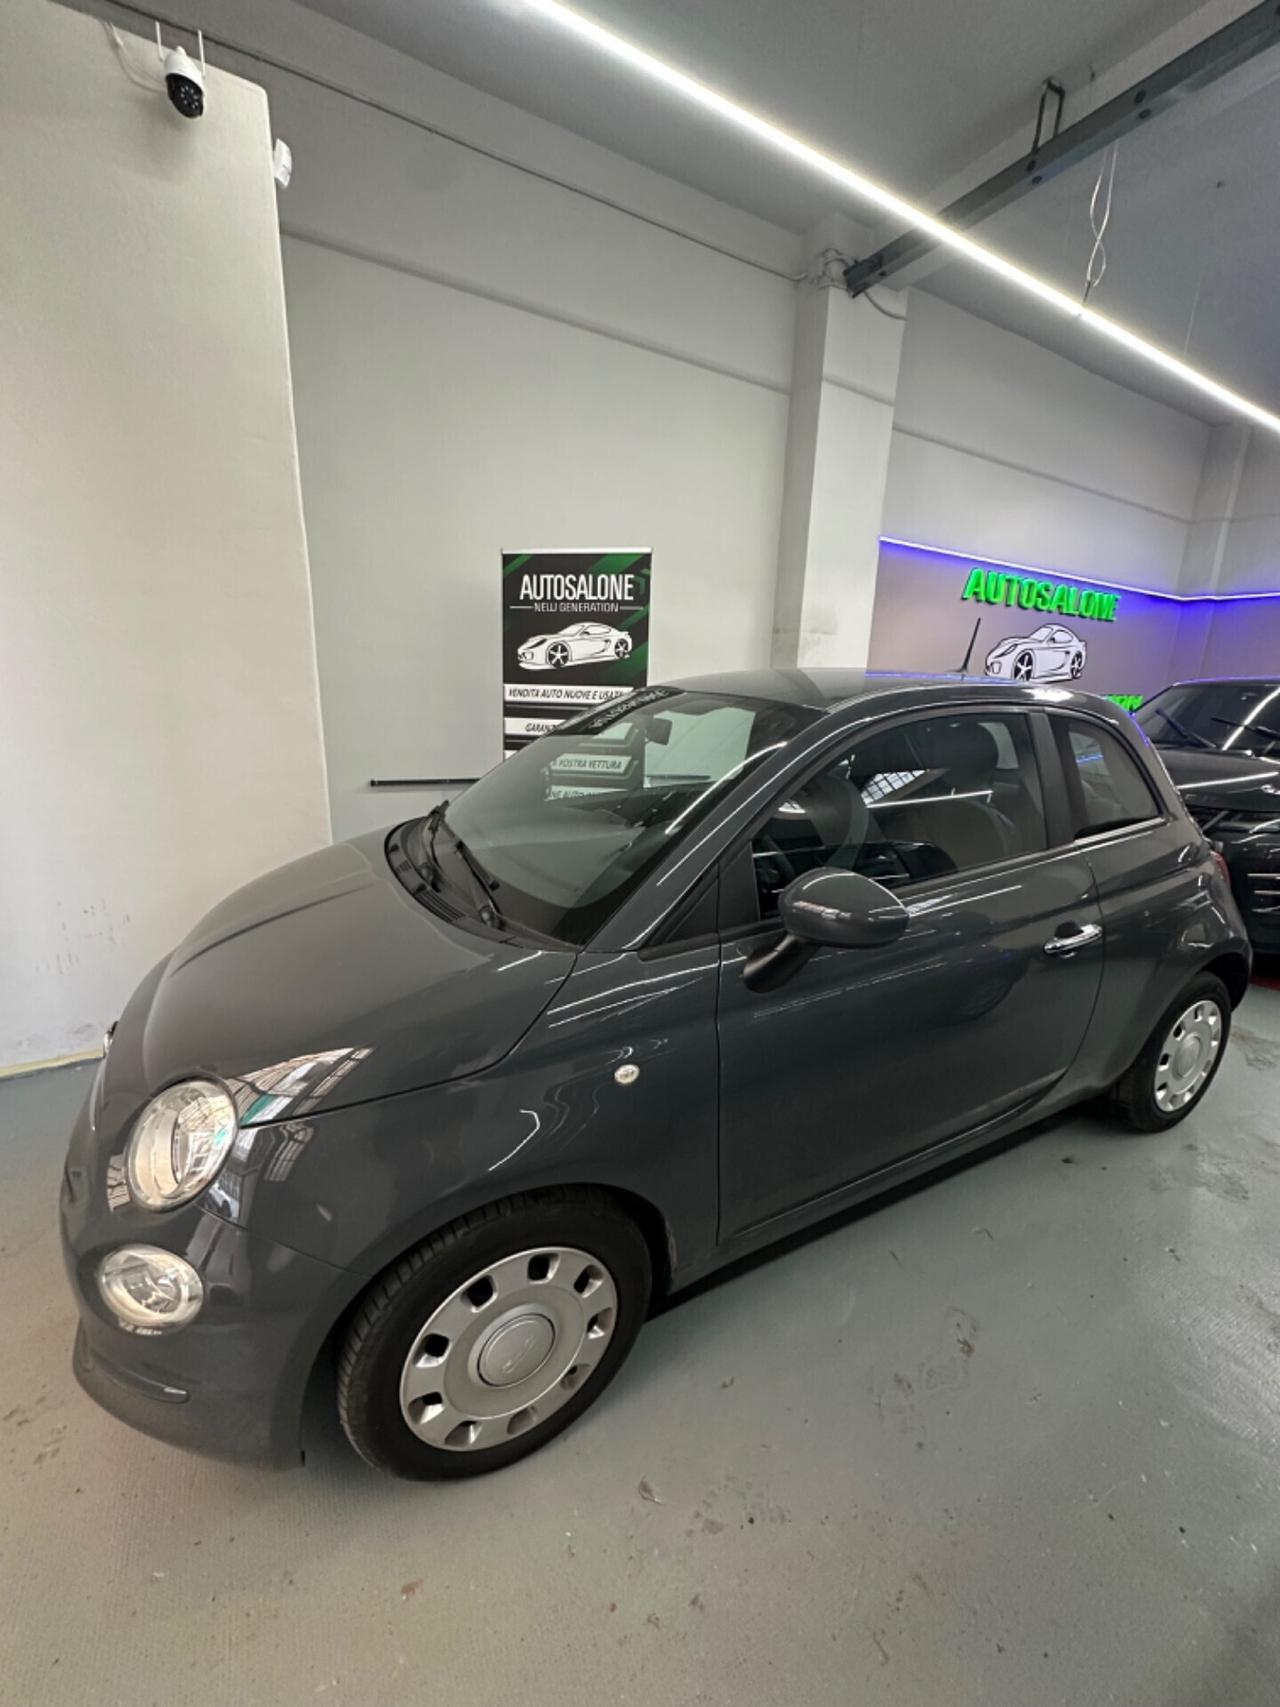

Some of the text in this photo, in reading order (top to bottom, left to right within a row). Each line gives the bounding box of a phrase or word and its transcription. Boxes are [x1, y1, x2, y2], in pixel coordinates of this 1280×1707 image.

[520, 573, 635, 600] AUTOSALONE
[962, 567, 1121, 622] AUTOSALONE
[559, 602, 619, 613] GENERATION
[508, 688, 539, 698] VENDITA
[541, 688, 563, 699] AUTO
[564, 689, 591, 700] NUOVE
[592, 690, 598, 700] E
[588, 759, 622, 770] VETTURA
